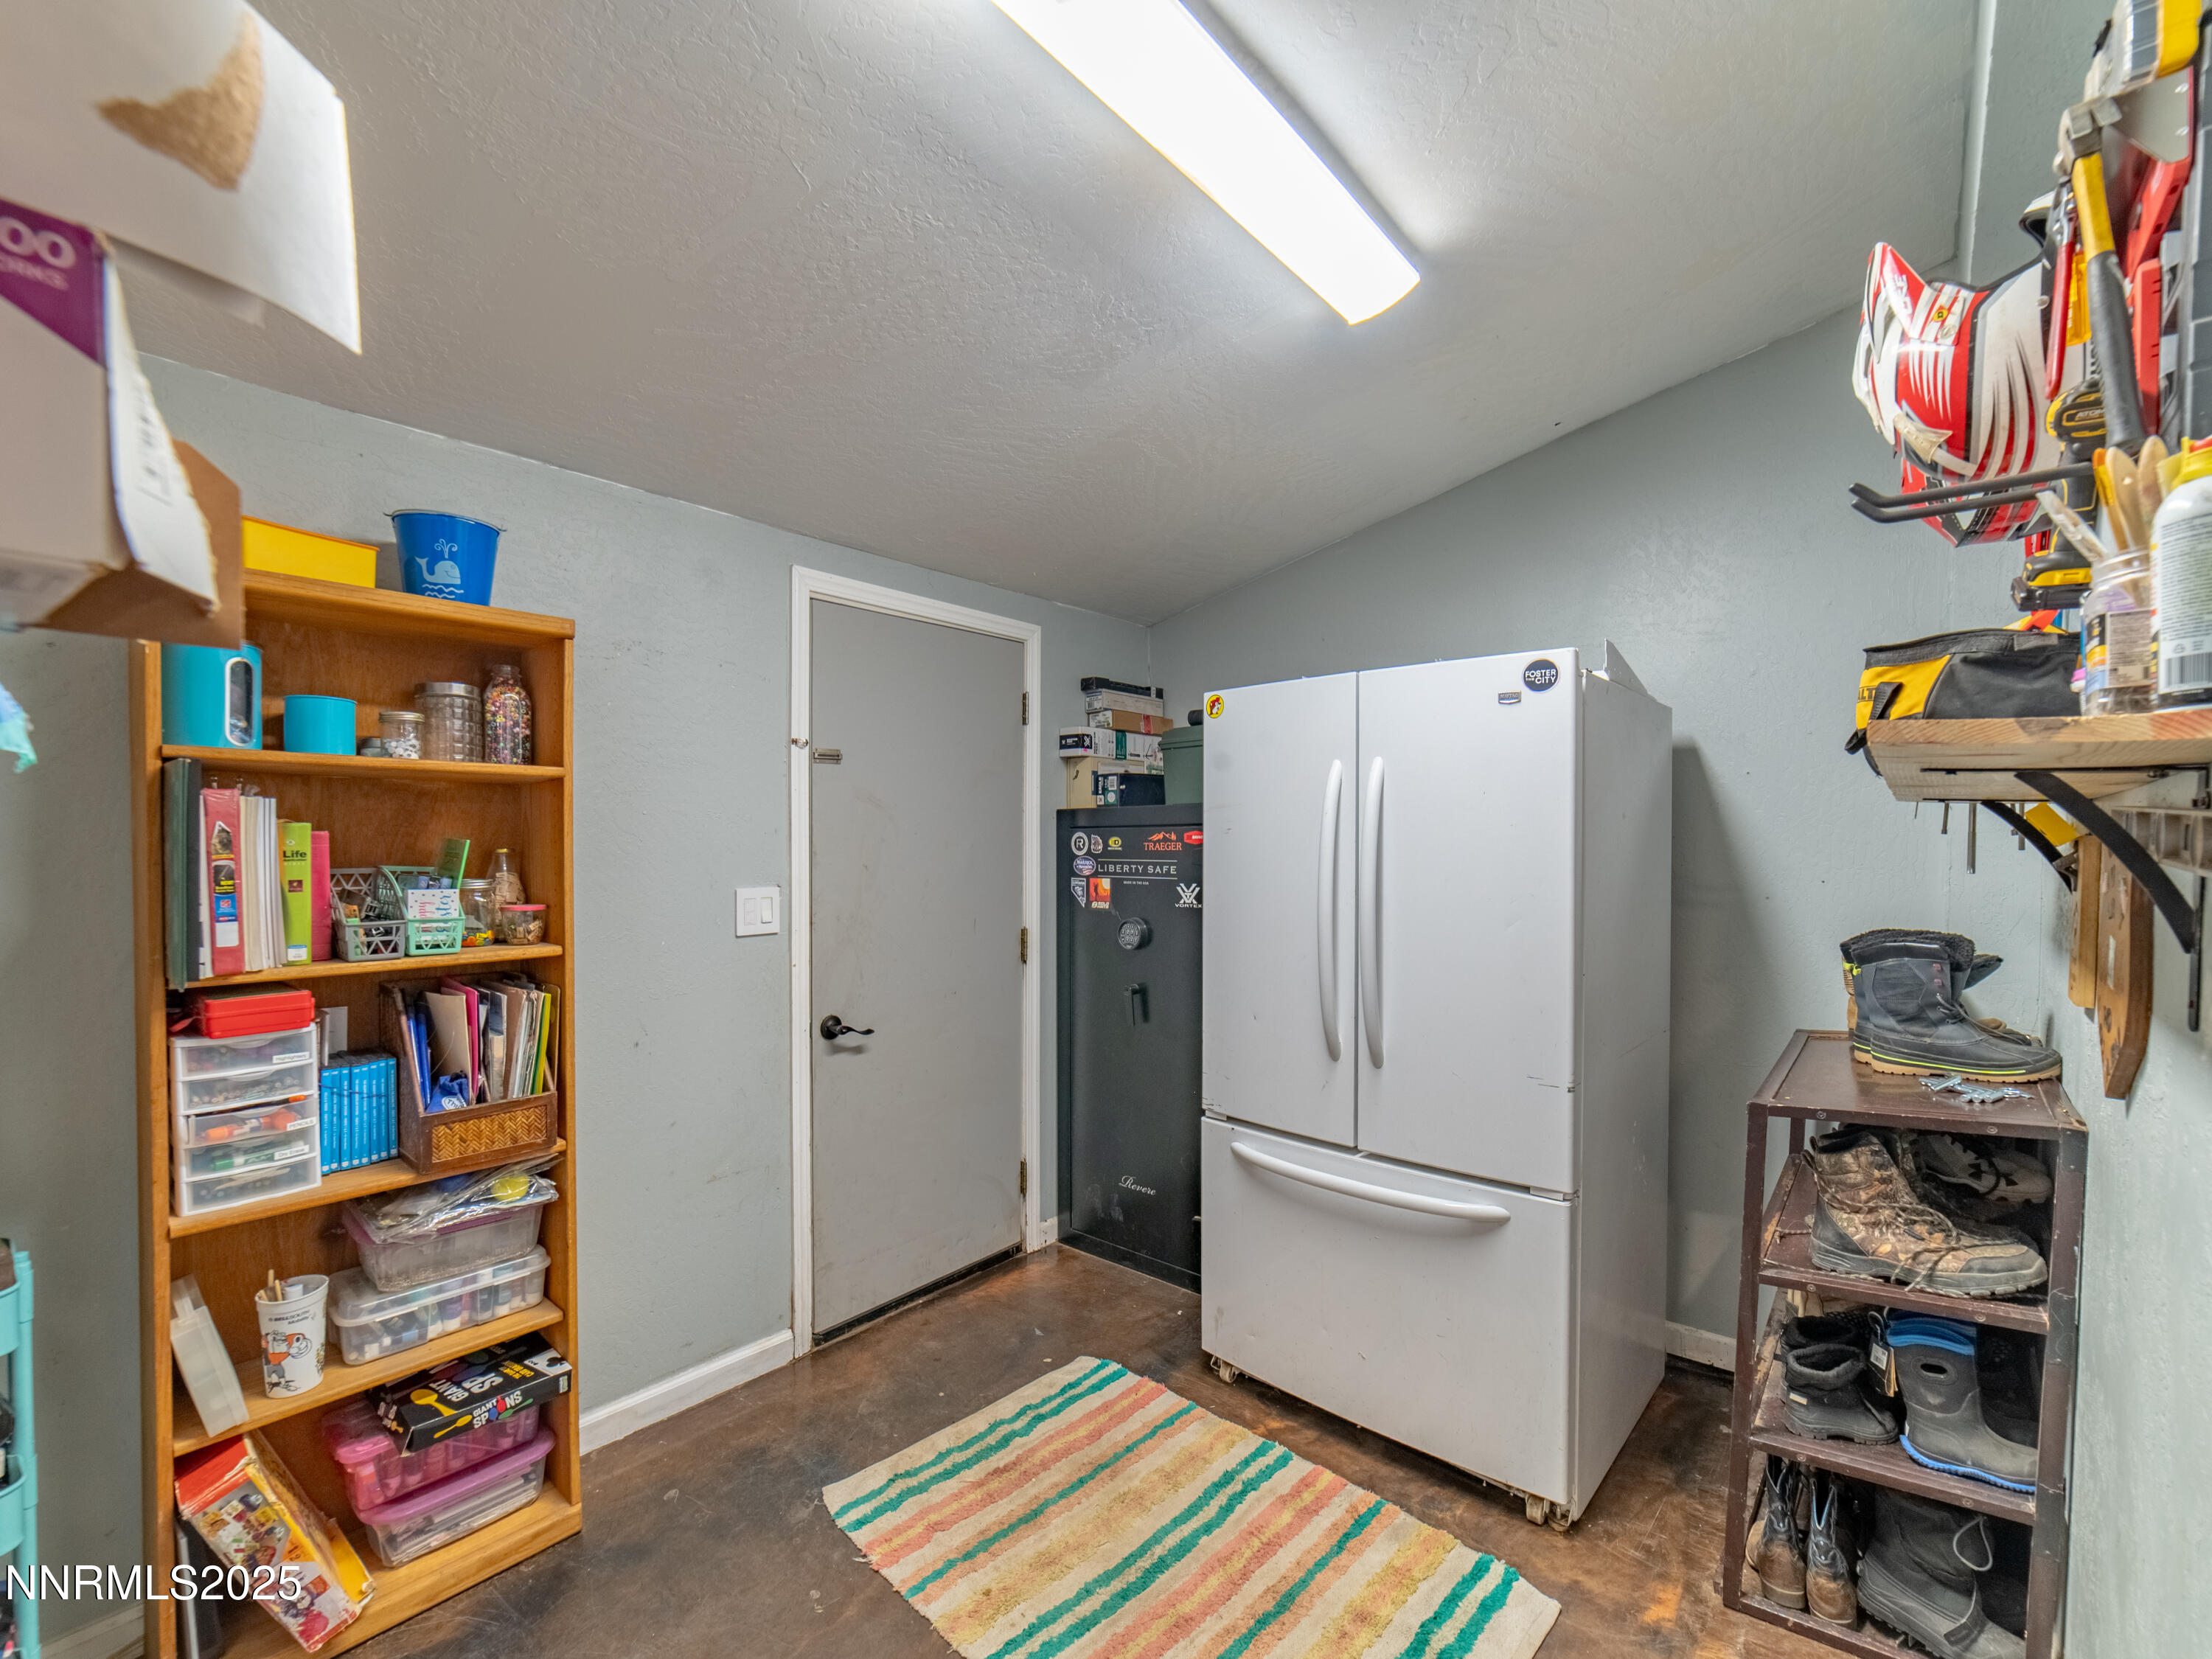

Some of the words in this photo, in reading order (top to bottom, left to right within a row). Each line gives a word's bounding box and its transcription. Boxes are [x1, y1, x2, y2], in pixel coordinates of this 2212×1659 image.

[1525, 669, 1556, 678] FOSTER
[1535, 676, 1556, 684] CITY
[1144, 842, 1182, 851] TRAEGER
[282, 850, 307, 858] Life
[1098, 864, 1144, 873] LIBERTY
[1147, 865, 1177, 874] SAFE
[1119, 1175, 1156, 1195] Revere
